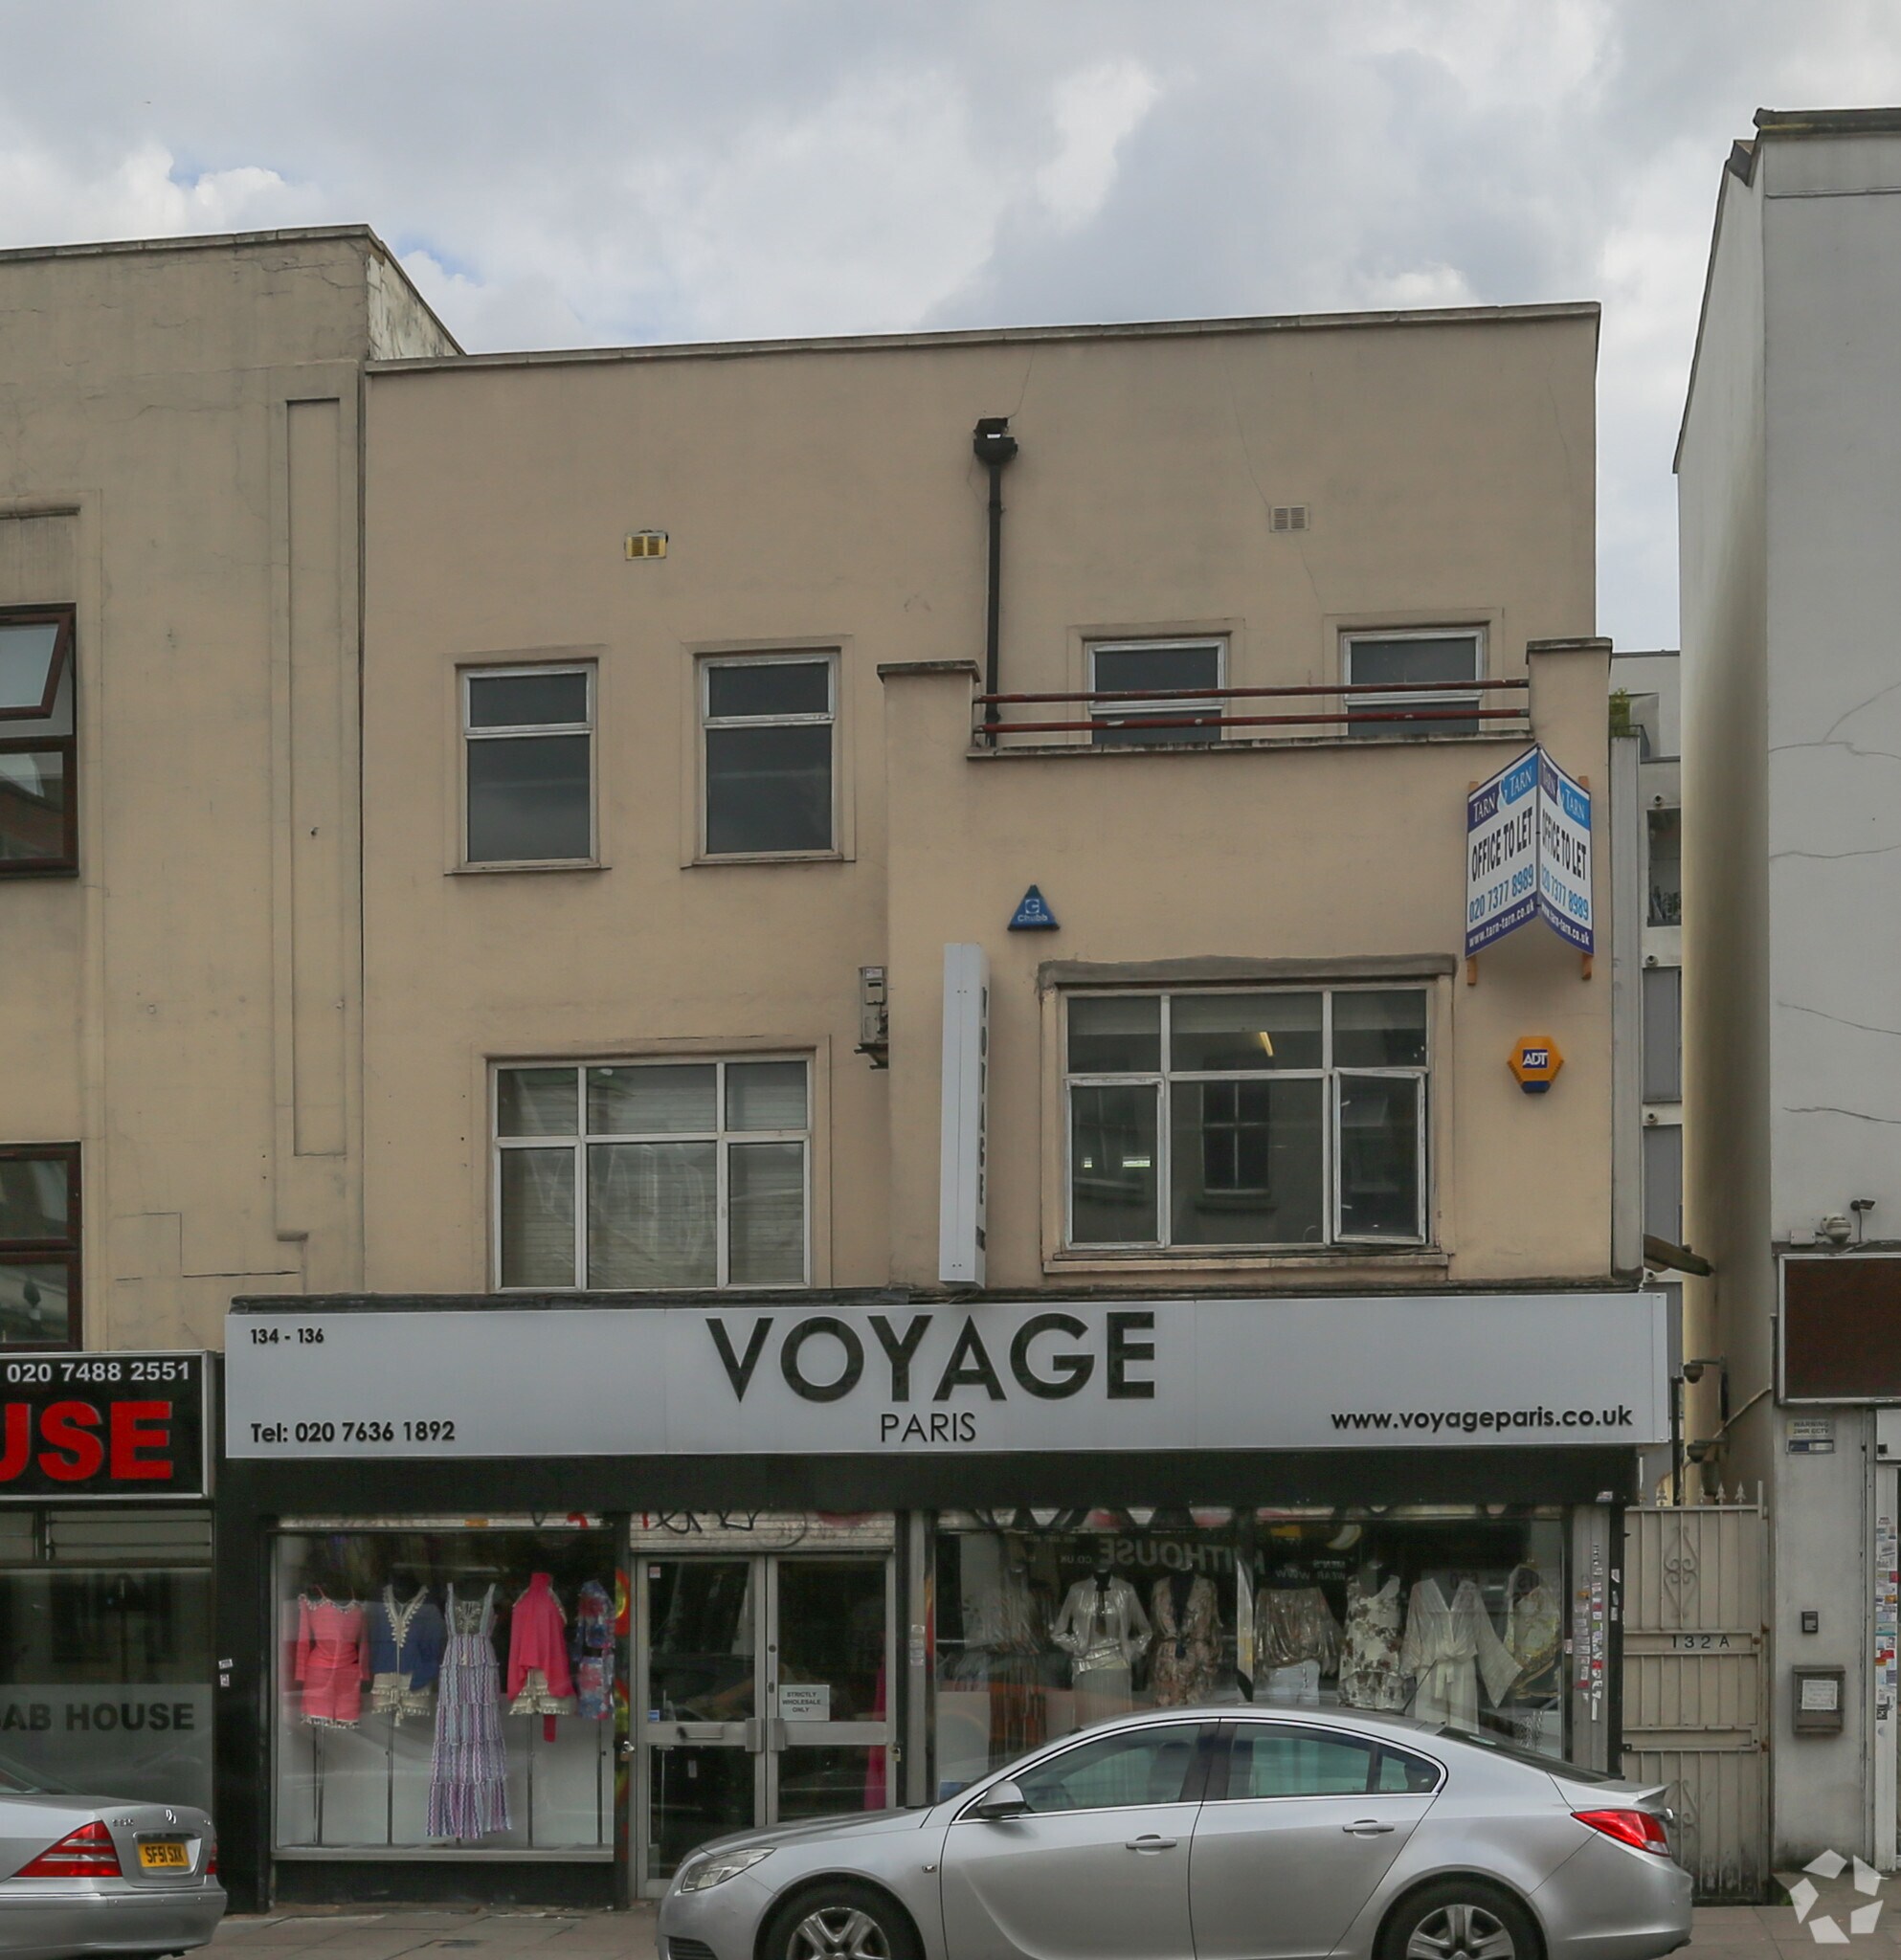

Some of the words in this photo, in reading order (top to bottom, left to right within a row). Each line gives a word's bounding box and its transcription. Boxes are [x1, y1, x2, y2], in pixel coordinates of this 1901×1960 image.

[1473, 792, 1496, 822] TARN
[1510, 765, 1532, 797] TARN
[1565, 789, 1586, 821] TARN
[1472, 828, 1502, 881] OFFICE
[1504, 818, 1515, 861] TO
[1517, 806, 1532, 854] LET
[1561, 829, 1571, 871] TO
[1573, 837, 1587, 880] LET
[1469, 894, 1486, 924] 020
[1487, 879, 1509, 912] 7377
[1512, 863, 1533, 897] 8989
[1552, 875, 1567, 906] 7377
[1569, 889, 1589, 921] 8989
[1469, 899, 1534, 948] www.tarn-tarn.co.uk
[1522, 1052, 1549, 1065] ADT
[251, 1327, 280, 1344] 134
[298, 1327, 324, 1344] 136
[7, 1363, 53, 1383] 020
[60, 1362, 123, 1382] 7488
[130, 1361, 190, 1381] 2551
[705, 1311, 1155, 1404] VOYAGE
[251, 1422, 288, 1442] Tel:
[295, 1422, 335, 1442] 020
[342, 1421, 394, 1441] 7636
[403, 1420, 456, 1441] 1892
[881, 1412, 977, 1443] PARIS
[1331, 1405, 1633, 1434] www.voyageparis.co.uk
[0, 1703, 52, 1731] AB
[66, 1703, 194, 1731] HOUSE
